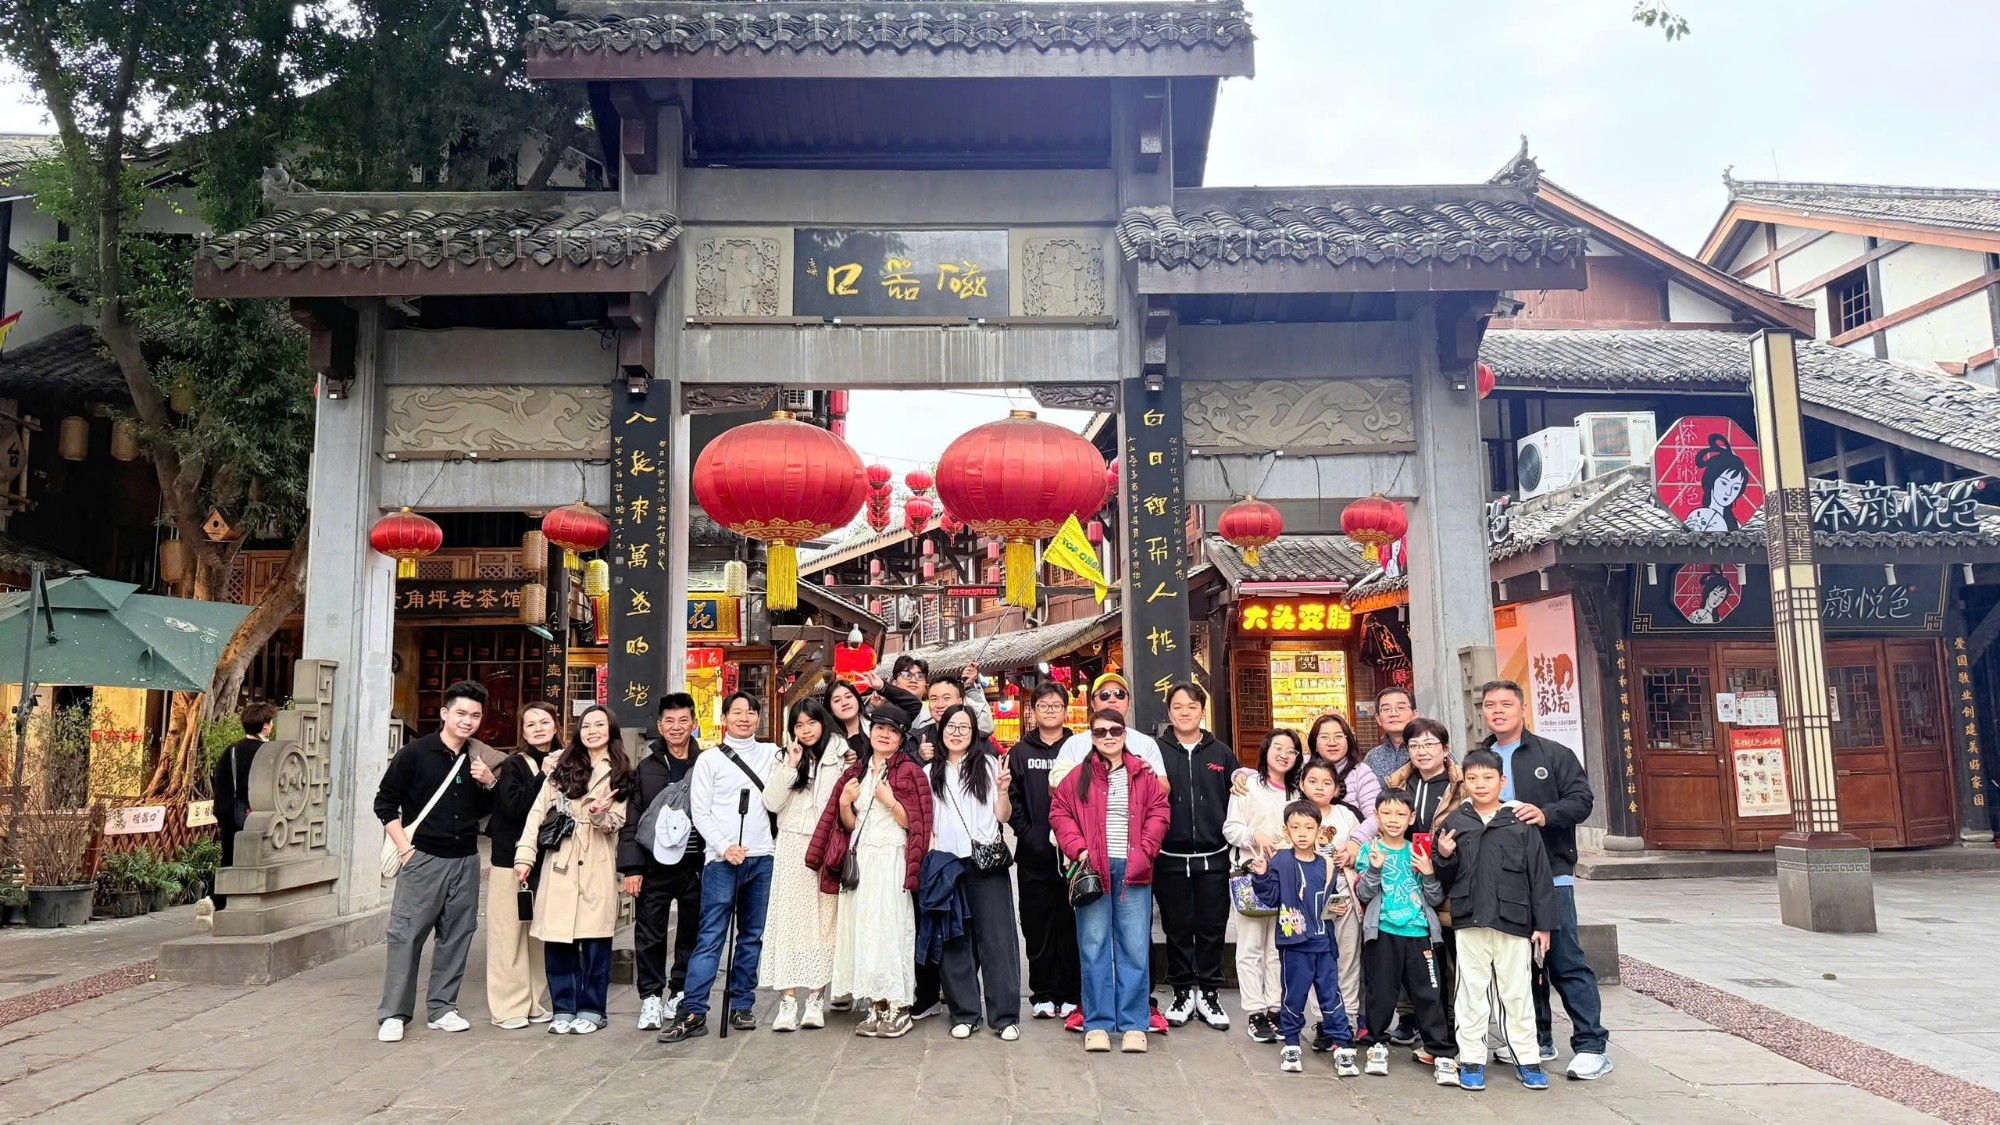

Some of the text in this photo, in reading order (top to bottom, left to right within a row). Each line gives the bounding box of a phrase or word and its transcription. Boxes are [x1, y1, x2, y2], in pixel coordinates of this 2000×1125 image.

[1062, 538, 1079, 553] TOP
[688, 601, 714, 630] 花
[1242, 603, 1352, 631] 大头变脸
[1953, 636, 1985, 807] 爱国敬业创建美好家园
